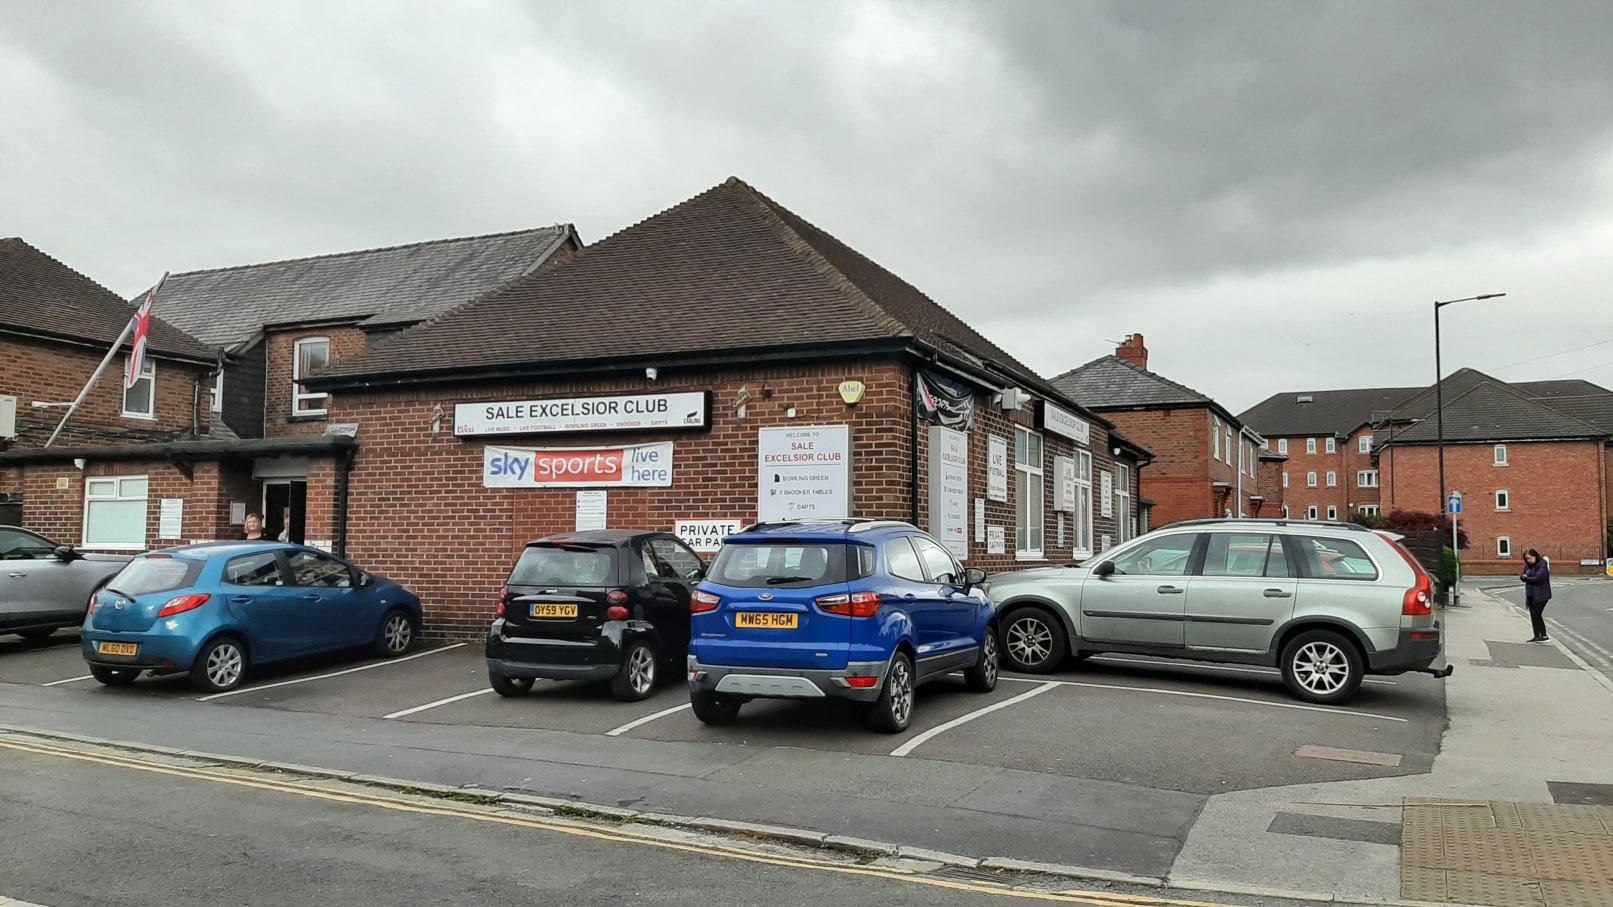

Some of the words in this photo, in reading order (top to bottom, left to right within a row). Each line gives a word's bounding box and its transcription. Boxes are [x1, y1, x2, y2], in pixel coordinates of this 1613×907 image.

[485, 405, 525, 420] SALE
[529, 401, 619, 418] EXCELSIOR
[623, 399, 668, 414] CLUB
[791, 442, 815, 450] SALE
[631, 448, 659, 463] live
[764, 453, 815, 462] EXCELSIOR
[816, 452, 842, 461] CLUB
[490, 452, 530, 481] sky
[539, 454, 617, 479] sports
[631, 466, 668, 481] here
[680, 524, 735, 536] PRIVATE
[705, 537, 723, 547] PA
[534, 605, 557, 615] OY59
[559, 605, 577, 615] YGV
[741, 613, 769, 625] MW65
[771, 614, 793, 626] HGM
